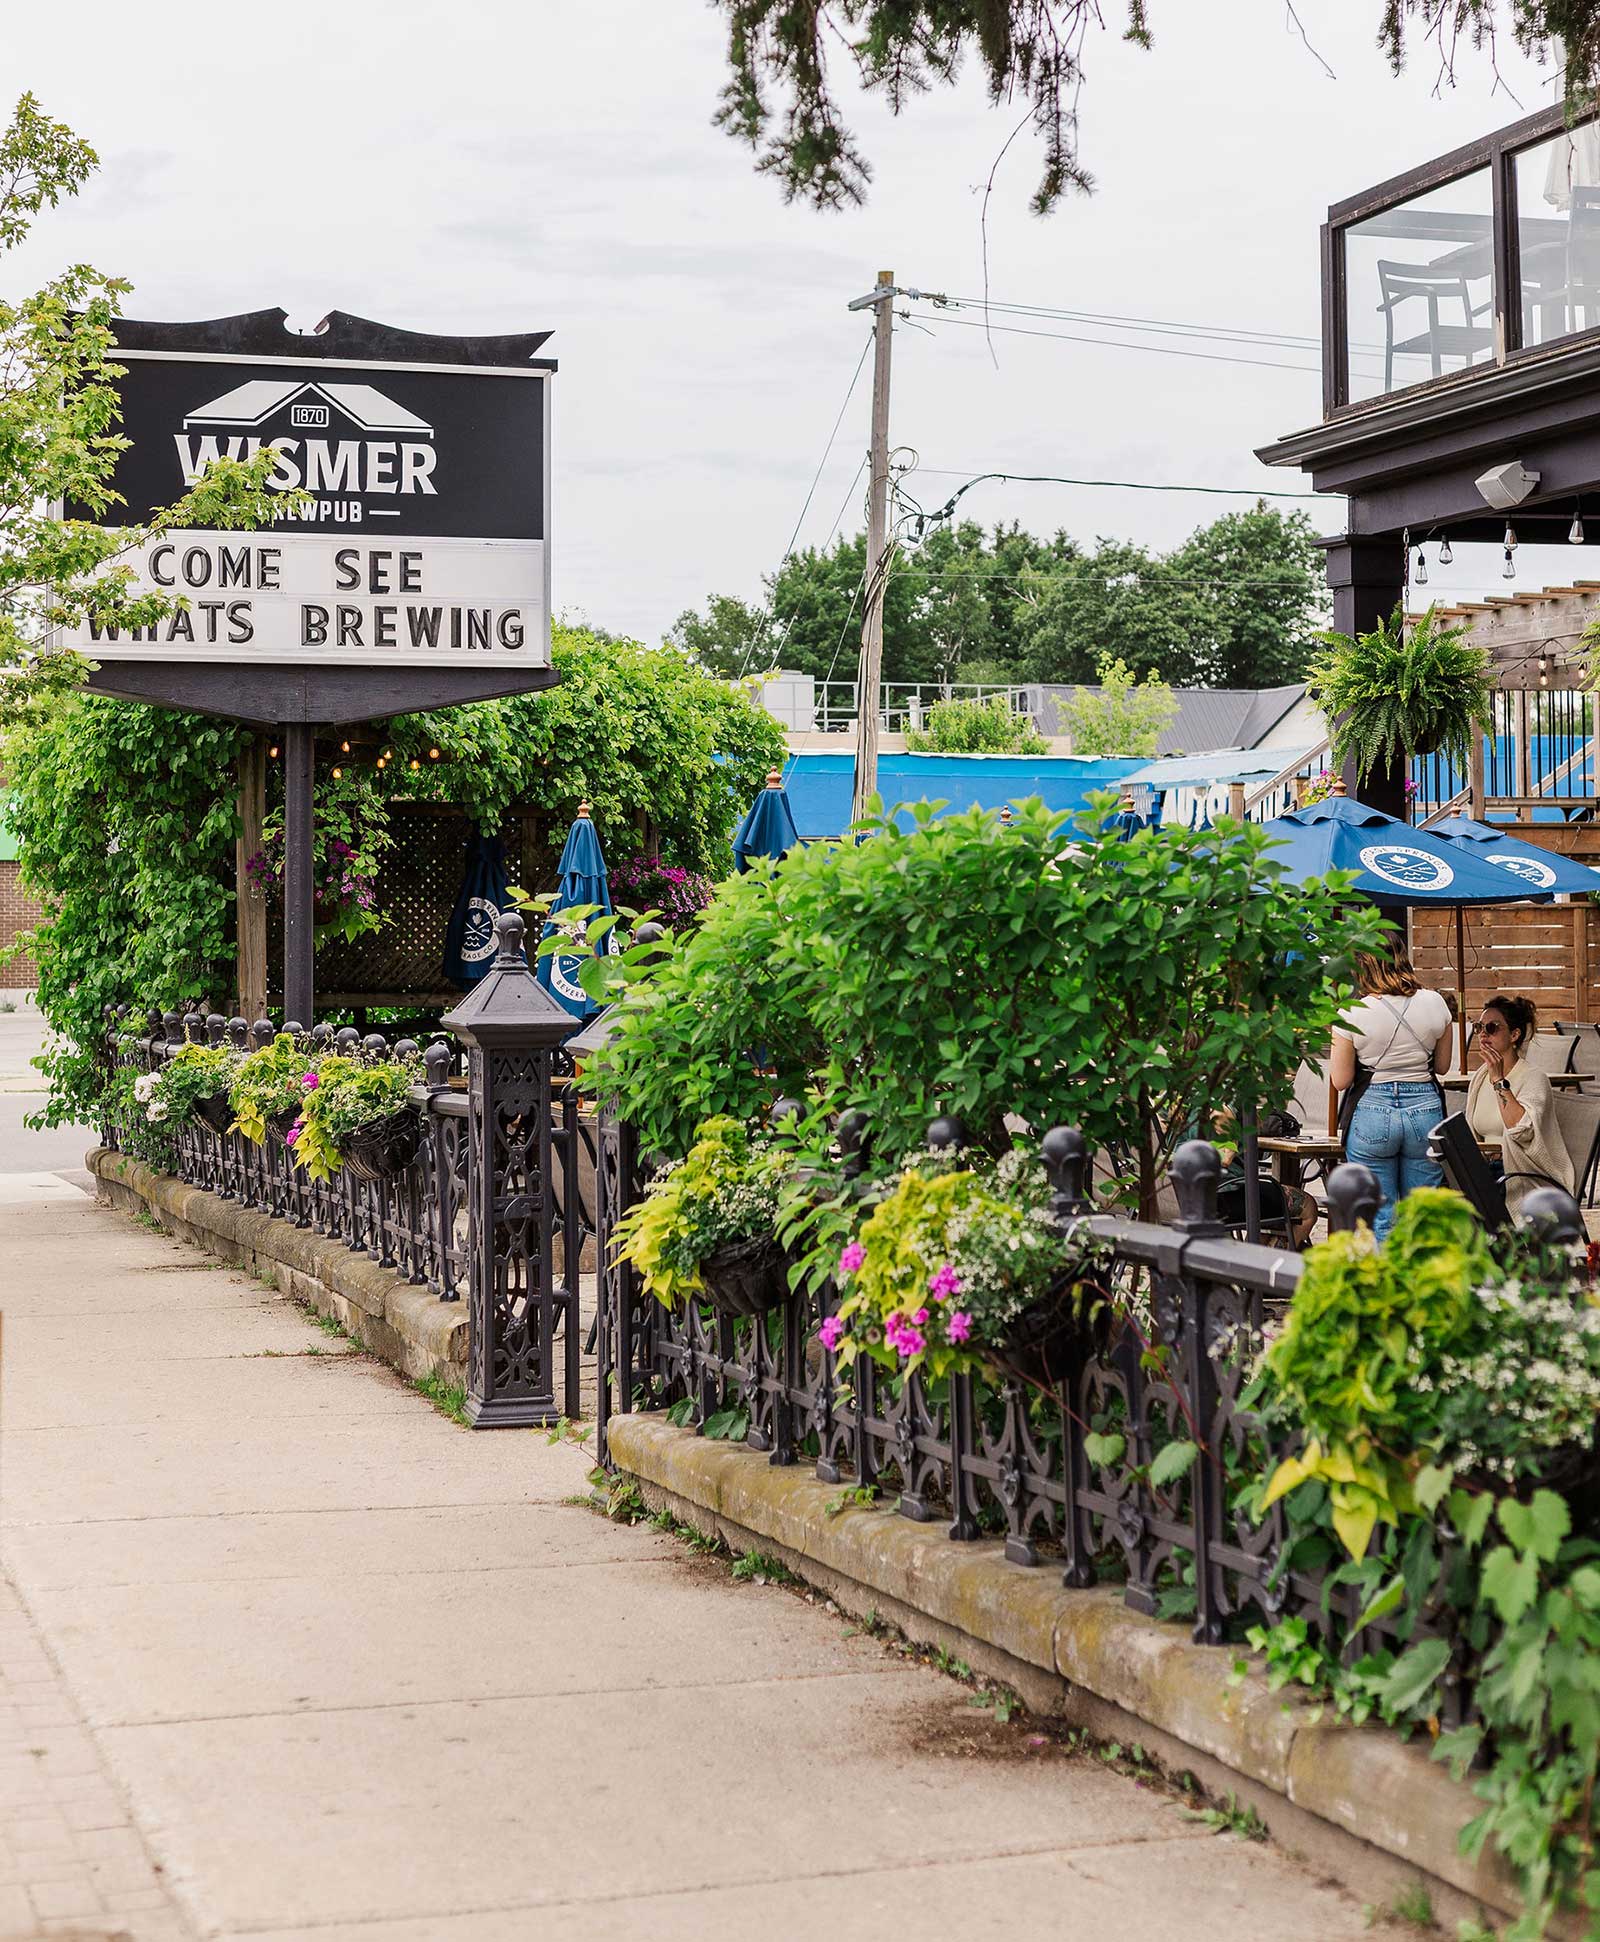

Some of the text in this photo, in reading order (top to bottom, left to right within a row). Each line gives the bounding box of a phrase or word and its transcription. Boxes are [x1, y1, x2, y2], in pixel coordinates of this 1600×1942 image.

[296, 408, 324, 424] 1870
[256, 498, 363, 523] REWPUB
[148, 544, 423, 594] COME SEE
[300, 604, 525, 650] BREWING
[555, 979, 586, 999] BEVERA
